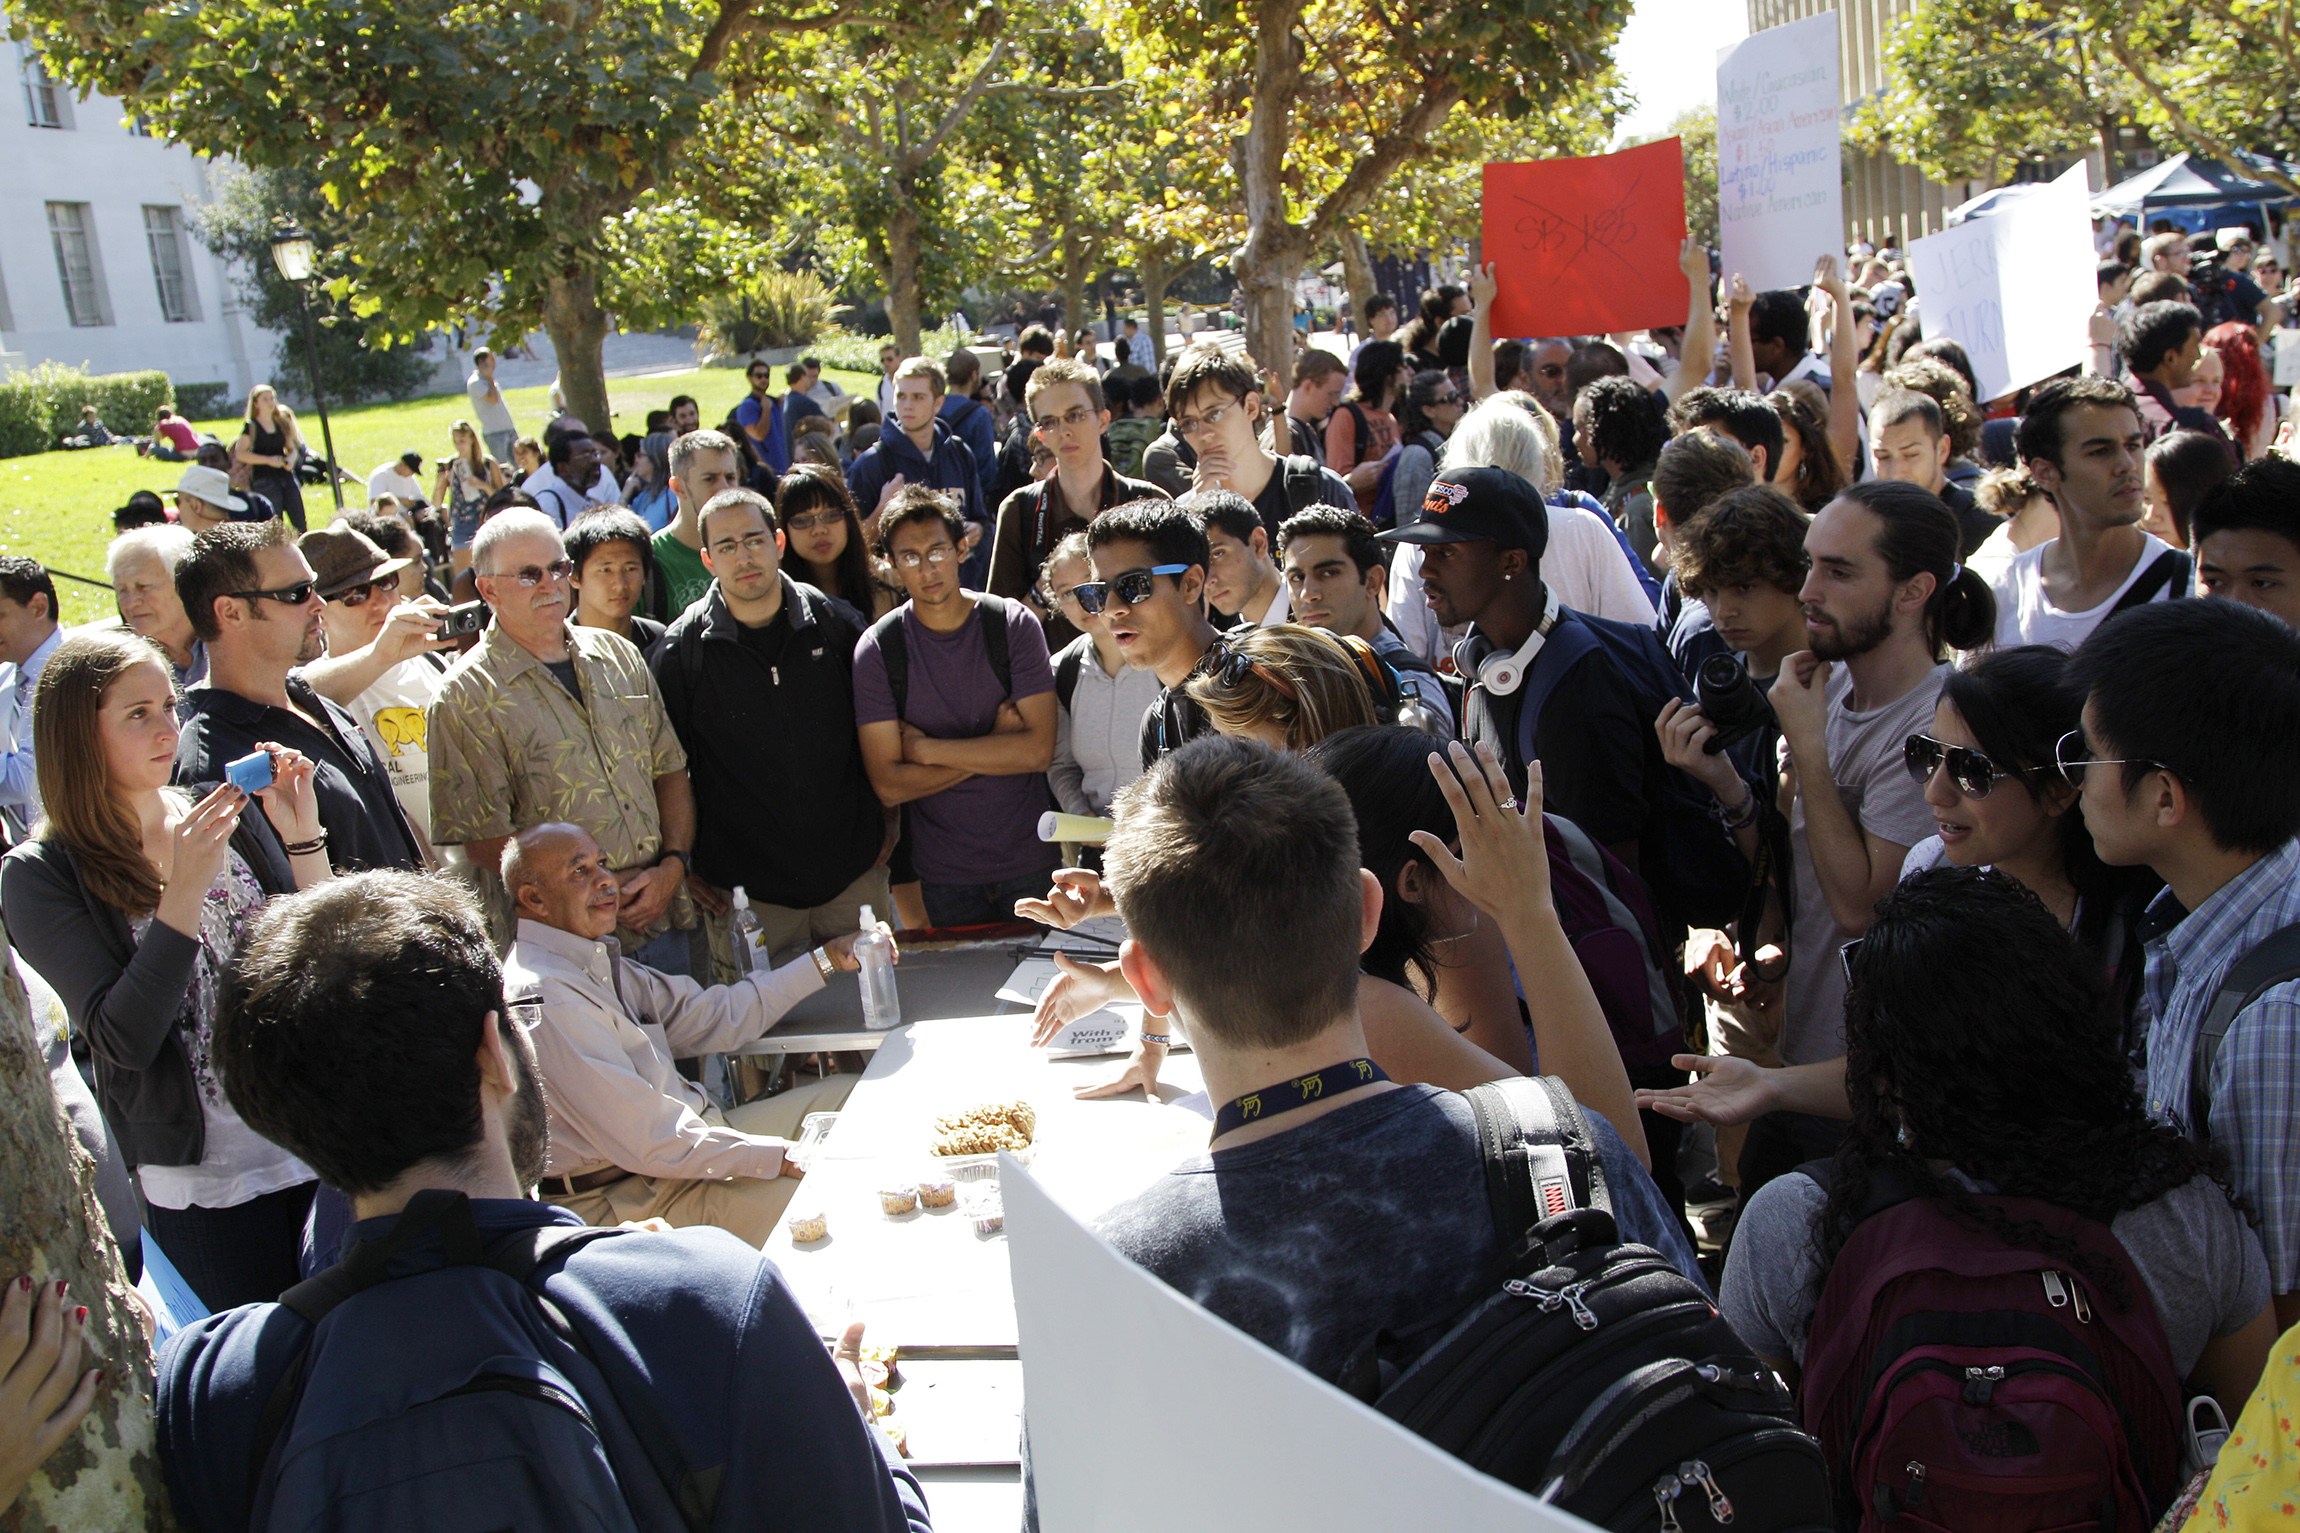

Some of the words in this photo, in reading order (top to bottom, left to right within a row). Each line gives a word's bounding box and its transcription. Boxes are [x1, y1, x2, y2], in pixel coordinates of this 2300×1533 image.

[1734, 94, 1778, 122] $2.00
[1721, 200, 1763, 222] Native
[1768, 190, 1827, 214] American
[1515, 215, 1566, 252] SB
[1035, 511, 1045, 546] DIGITAL
[1070, 1036, 1113, 1045] from
[1072, 1029, 1110, 1038] With
[1969, 1443, 2012, 1457] FACE
